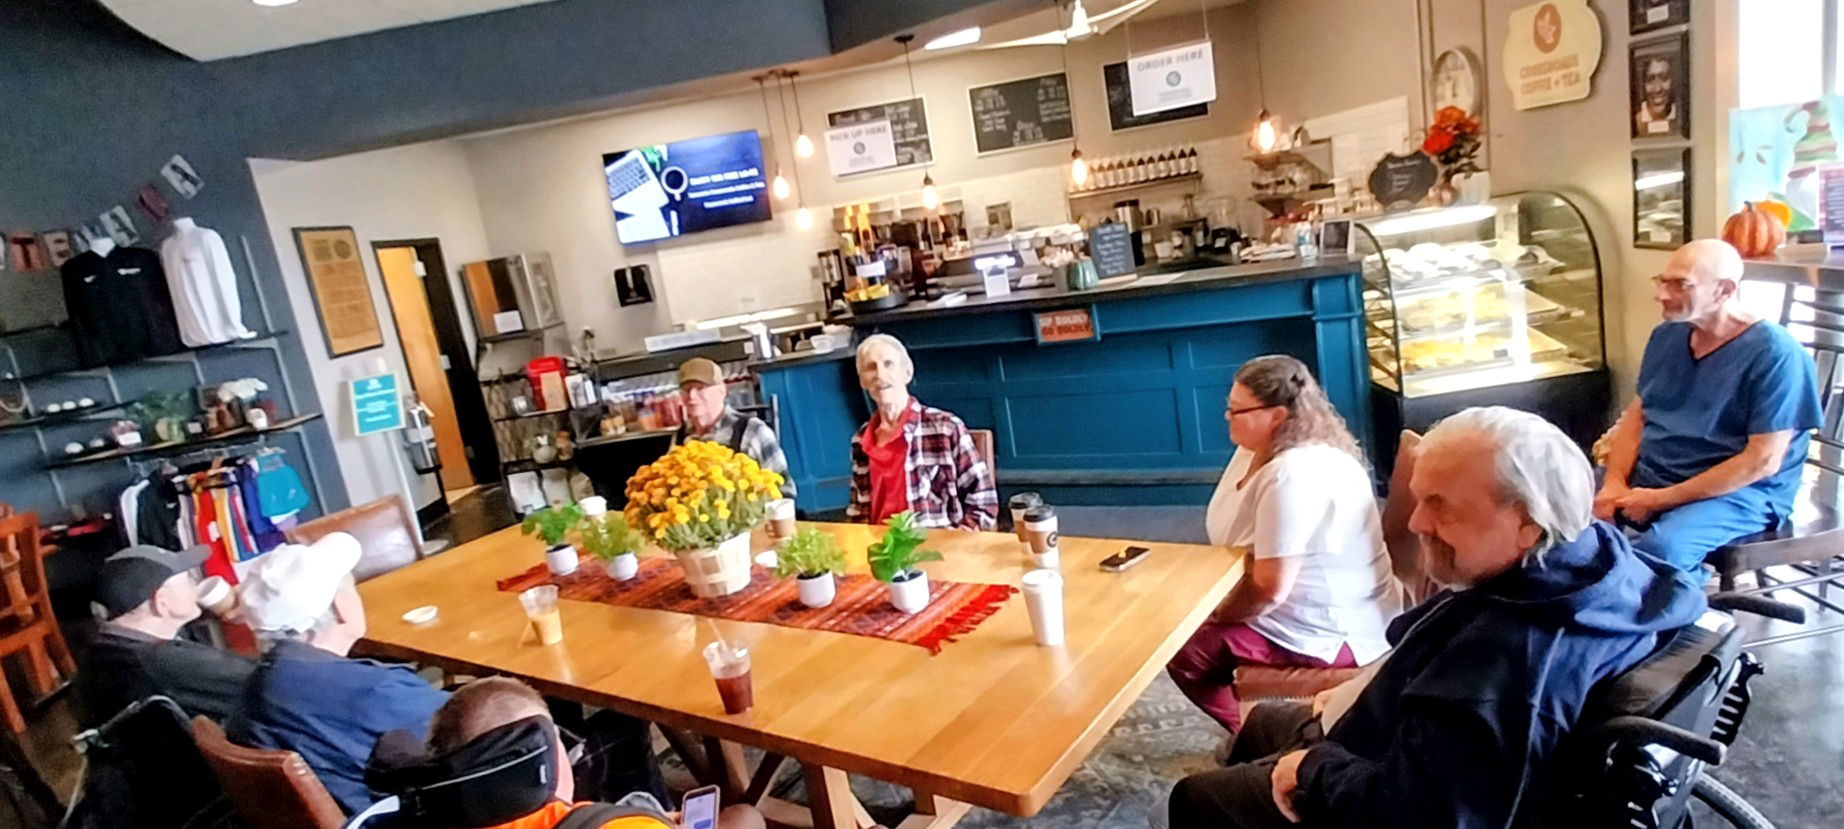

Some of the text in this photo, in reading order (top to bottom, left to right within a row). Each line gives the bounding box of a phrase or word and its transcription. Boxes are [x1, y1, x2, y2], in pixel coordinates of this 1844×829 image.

[1137, 49, 1203, 72] ORDER HERE
[851, 129, 863, 139] UP
[864, 124, 887, 136] HERE
